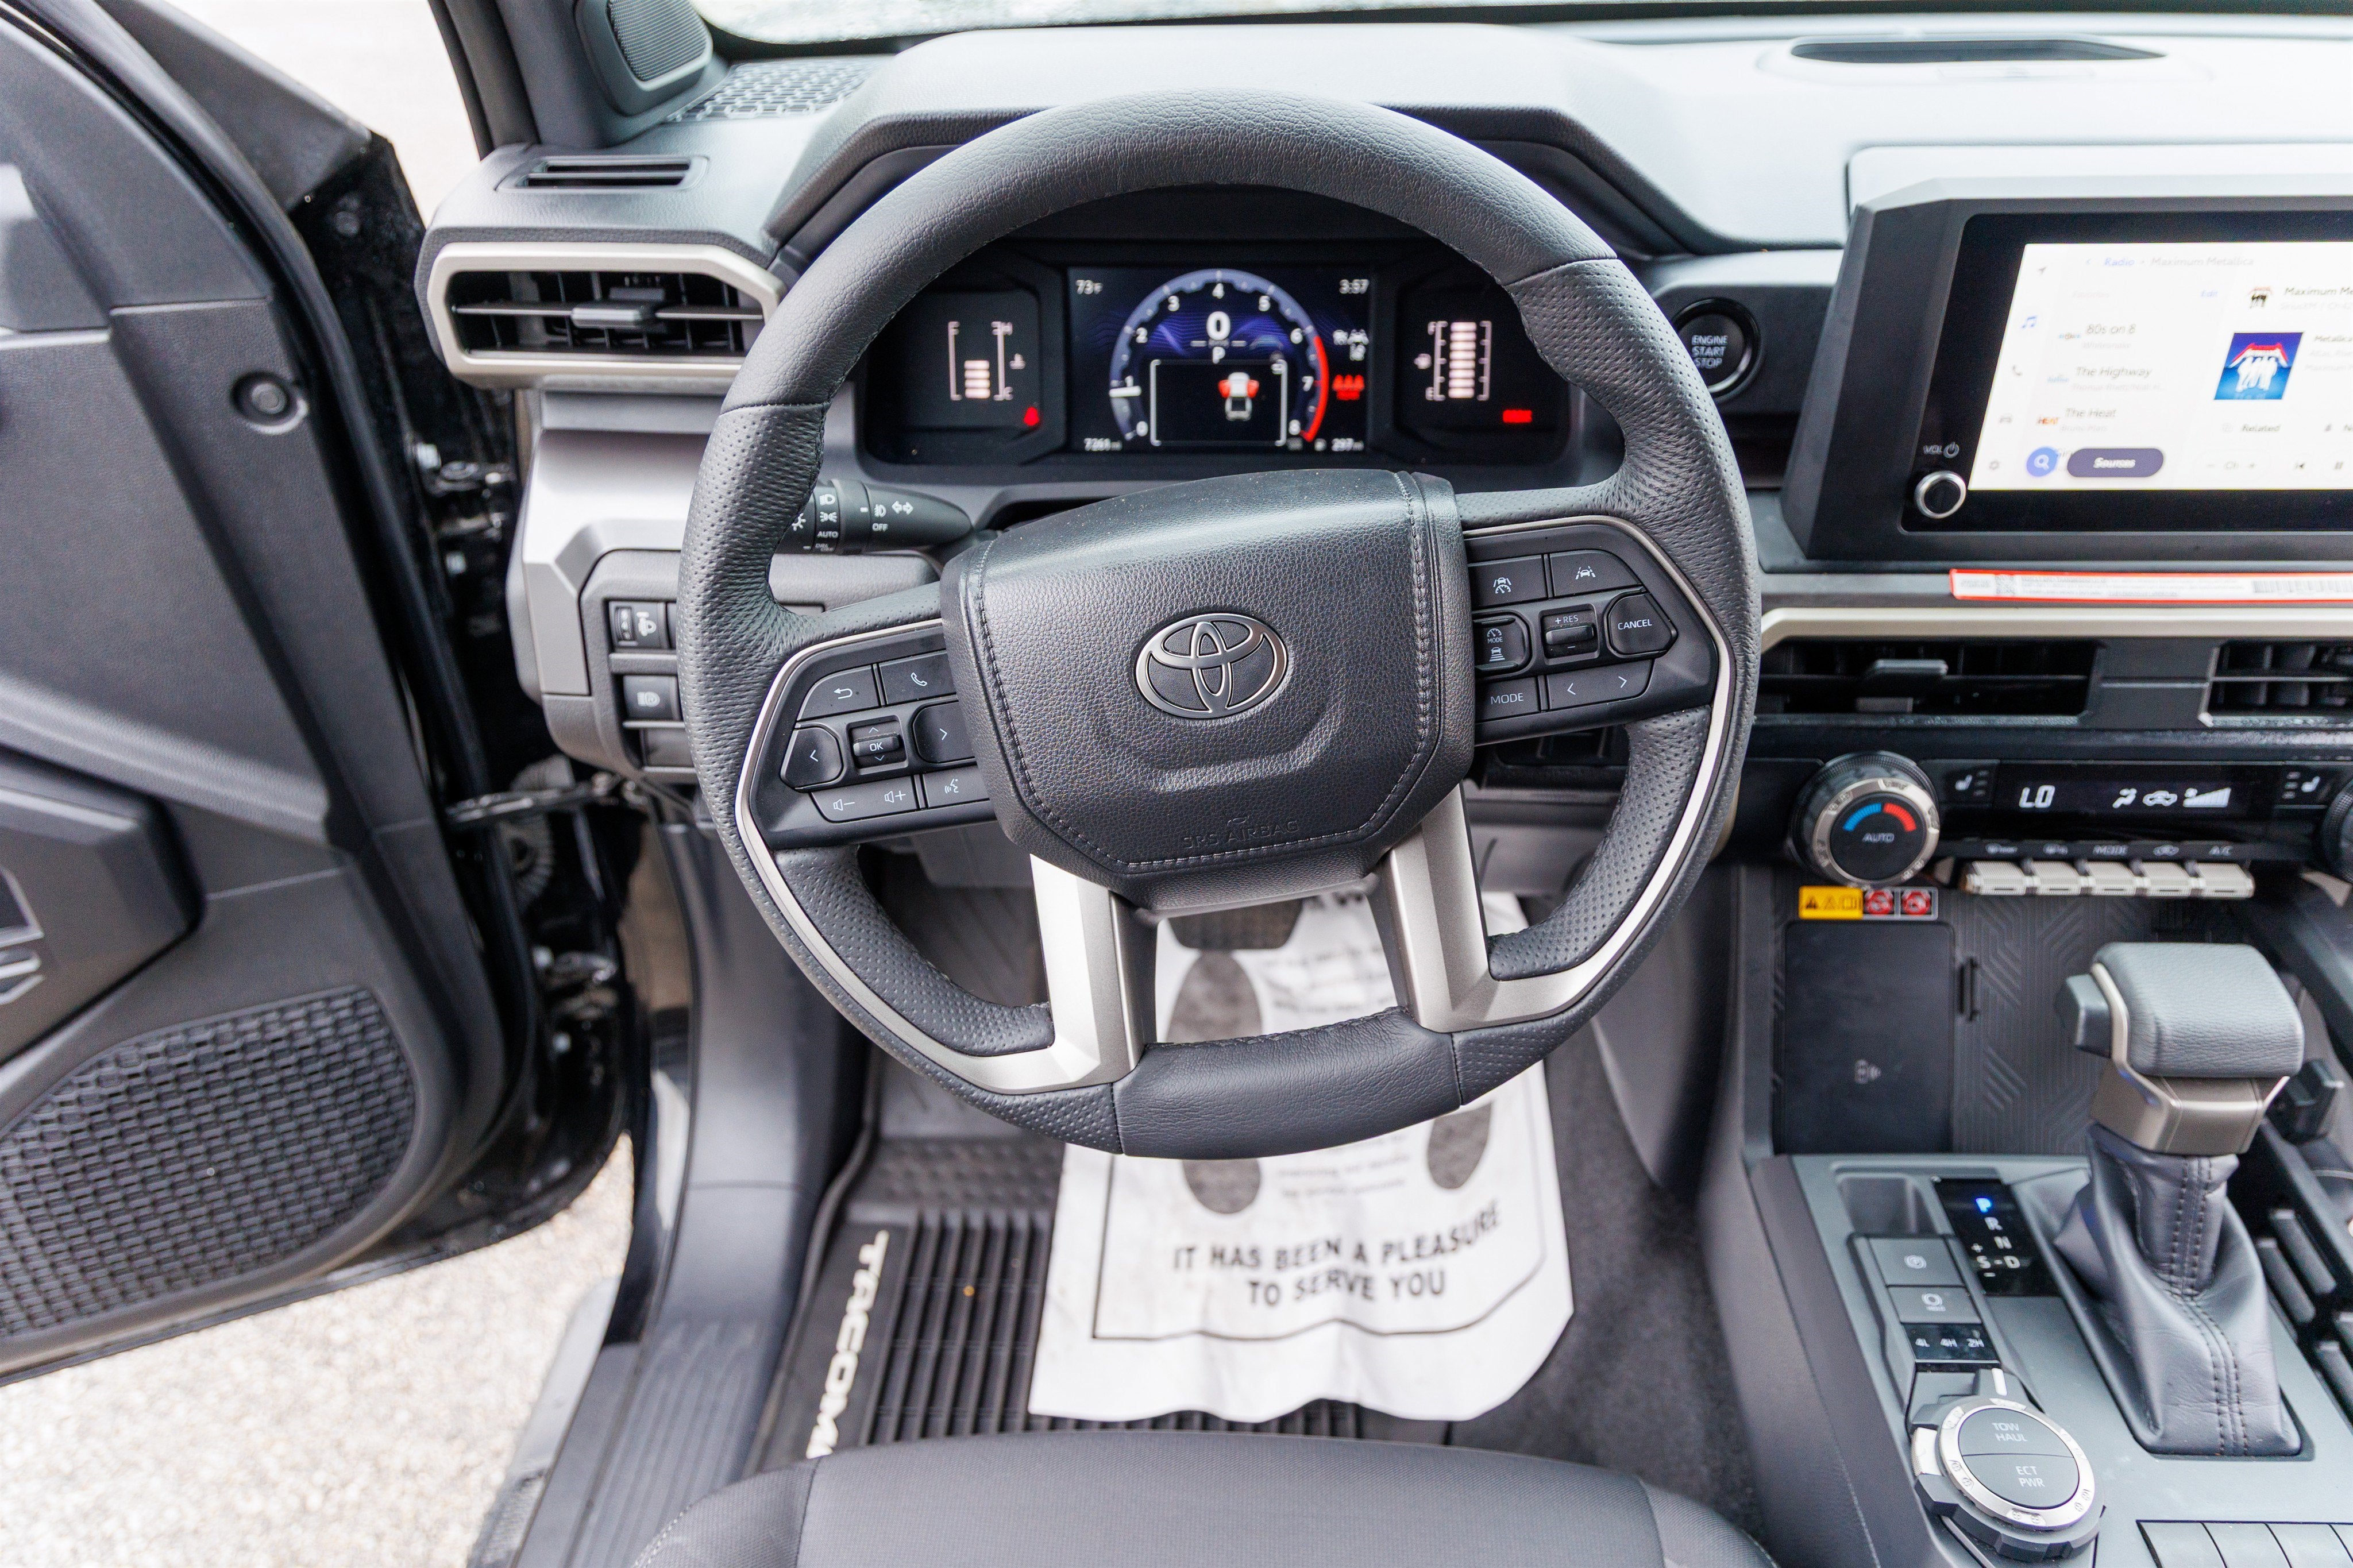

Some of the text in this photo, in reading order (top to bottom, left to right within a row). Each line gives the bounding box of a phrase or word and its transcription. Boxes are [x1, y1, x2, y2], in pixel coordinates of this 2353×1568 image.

[2104, 257, 2254, 266] Radio Maximum Metallica
[1212, 283, 1224, 299] 4
[1339, 279, 1370, 294] 3:57
[2284, 287, 2337, 295] Maximum
[2200, 289, 2219, 298] Edit
[1168, 296, 1179, 311] 3
[1259, 296, 1271, 311] 5
[1207, 311, 1231, 341] 0
[1136, 327, 1148, 343] 2
[1290, 328, 1303, 344] 6
[1692, 335, 1728, 345] ENGINE
[1212, 346, 1226, 364] P
[1692, 346, 1726, 358] START
[1694, 358, 1723, 369] STOP
[2076, 366, 2152, 380] The Highway
[1302, 376, 1314, 392] 7
[2066, 408, 2116, 418] The Heat
[2241, 423, 2281, 432] Related
[1923, 445, 1942, 454] VOL
[2094, 458, 2135, 468] Sources
[872, 523, 889, 532] OFF
[817, 531, 839, 539] AUTO
[1617, 618, 1653, 630] CANCEL
[1490, 692, 1524, 704] MODE
[869, 742, 883, 751] OK
[2019, 785, 2055, 808] LO
[1228, 820, 1300, 843] AIRBAG
[1862, 833, 1895, 843] AUTO
[2209, 845, 2233, 856] A/C
[1975, 1198, 1992, 1212] P
[1984, 1216, 2003, 1230] R
[1173, 1198, 1500, 1272] IT HAS BEEN A PLEASURE
[1993, 1236, 2012, 1249] N
[1976, 1256, 2020, 1268] S D
[1248, 1268, 1445, 1307] TO SERVE YOU
[1915, 1338, 1985, 1347] 4L 4H 2H
[1992, 1422, 2020, 1431] TOW
[1995, 1433, 2028, 1442] HAUL
[2015, 1466, 2038, 1475] ECT
[2018, 1477, 2046, 1487] PWR
